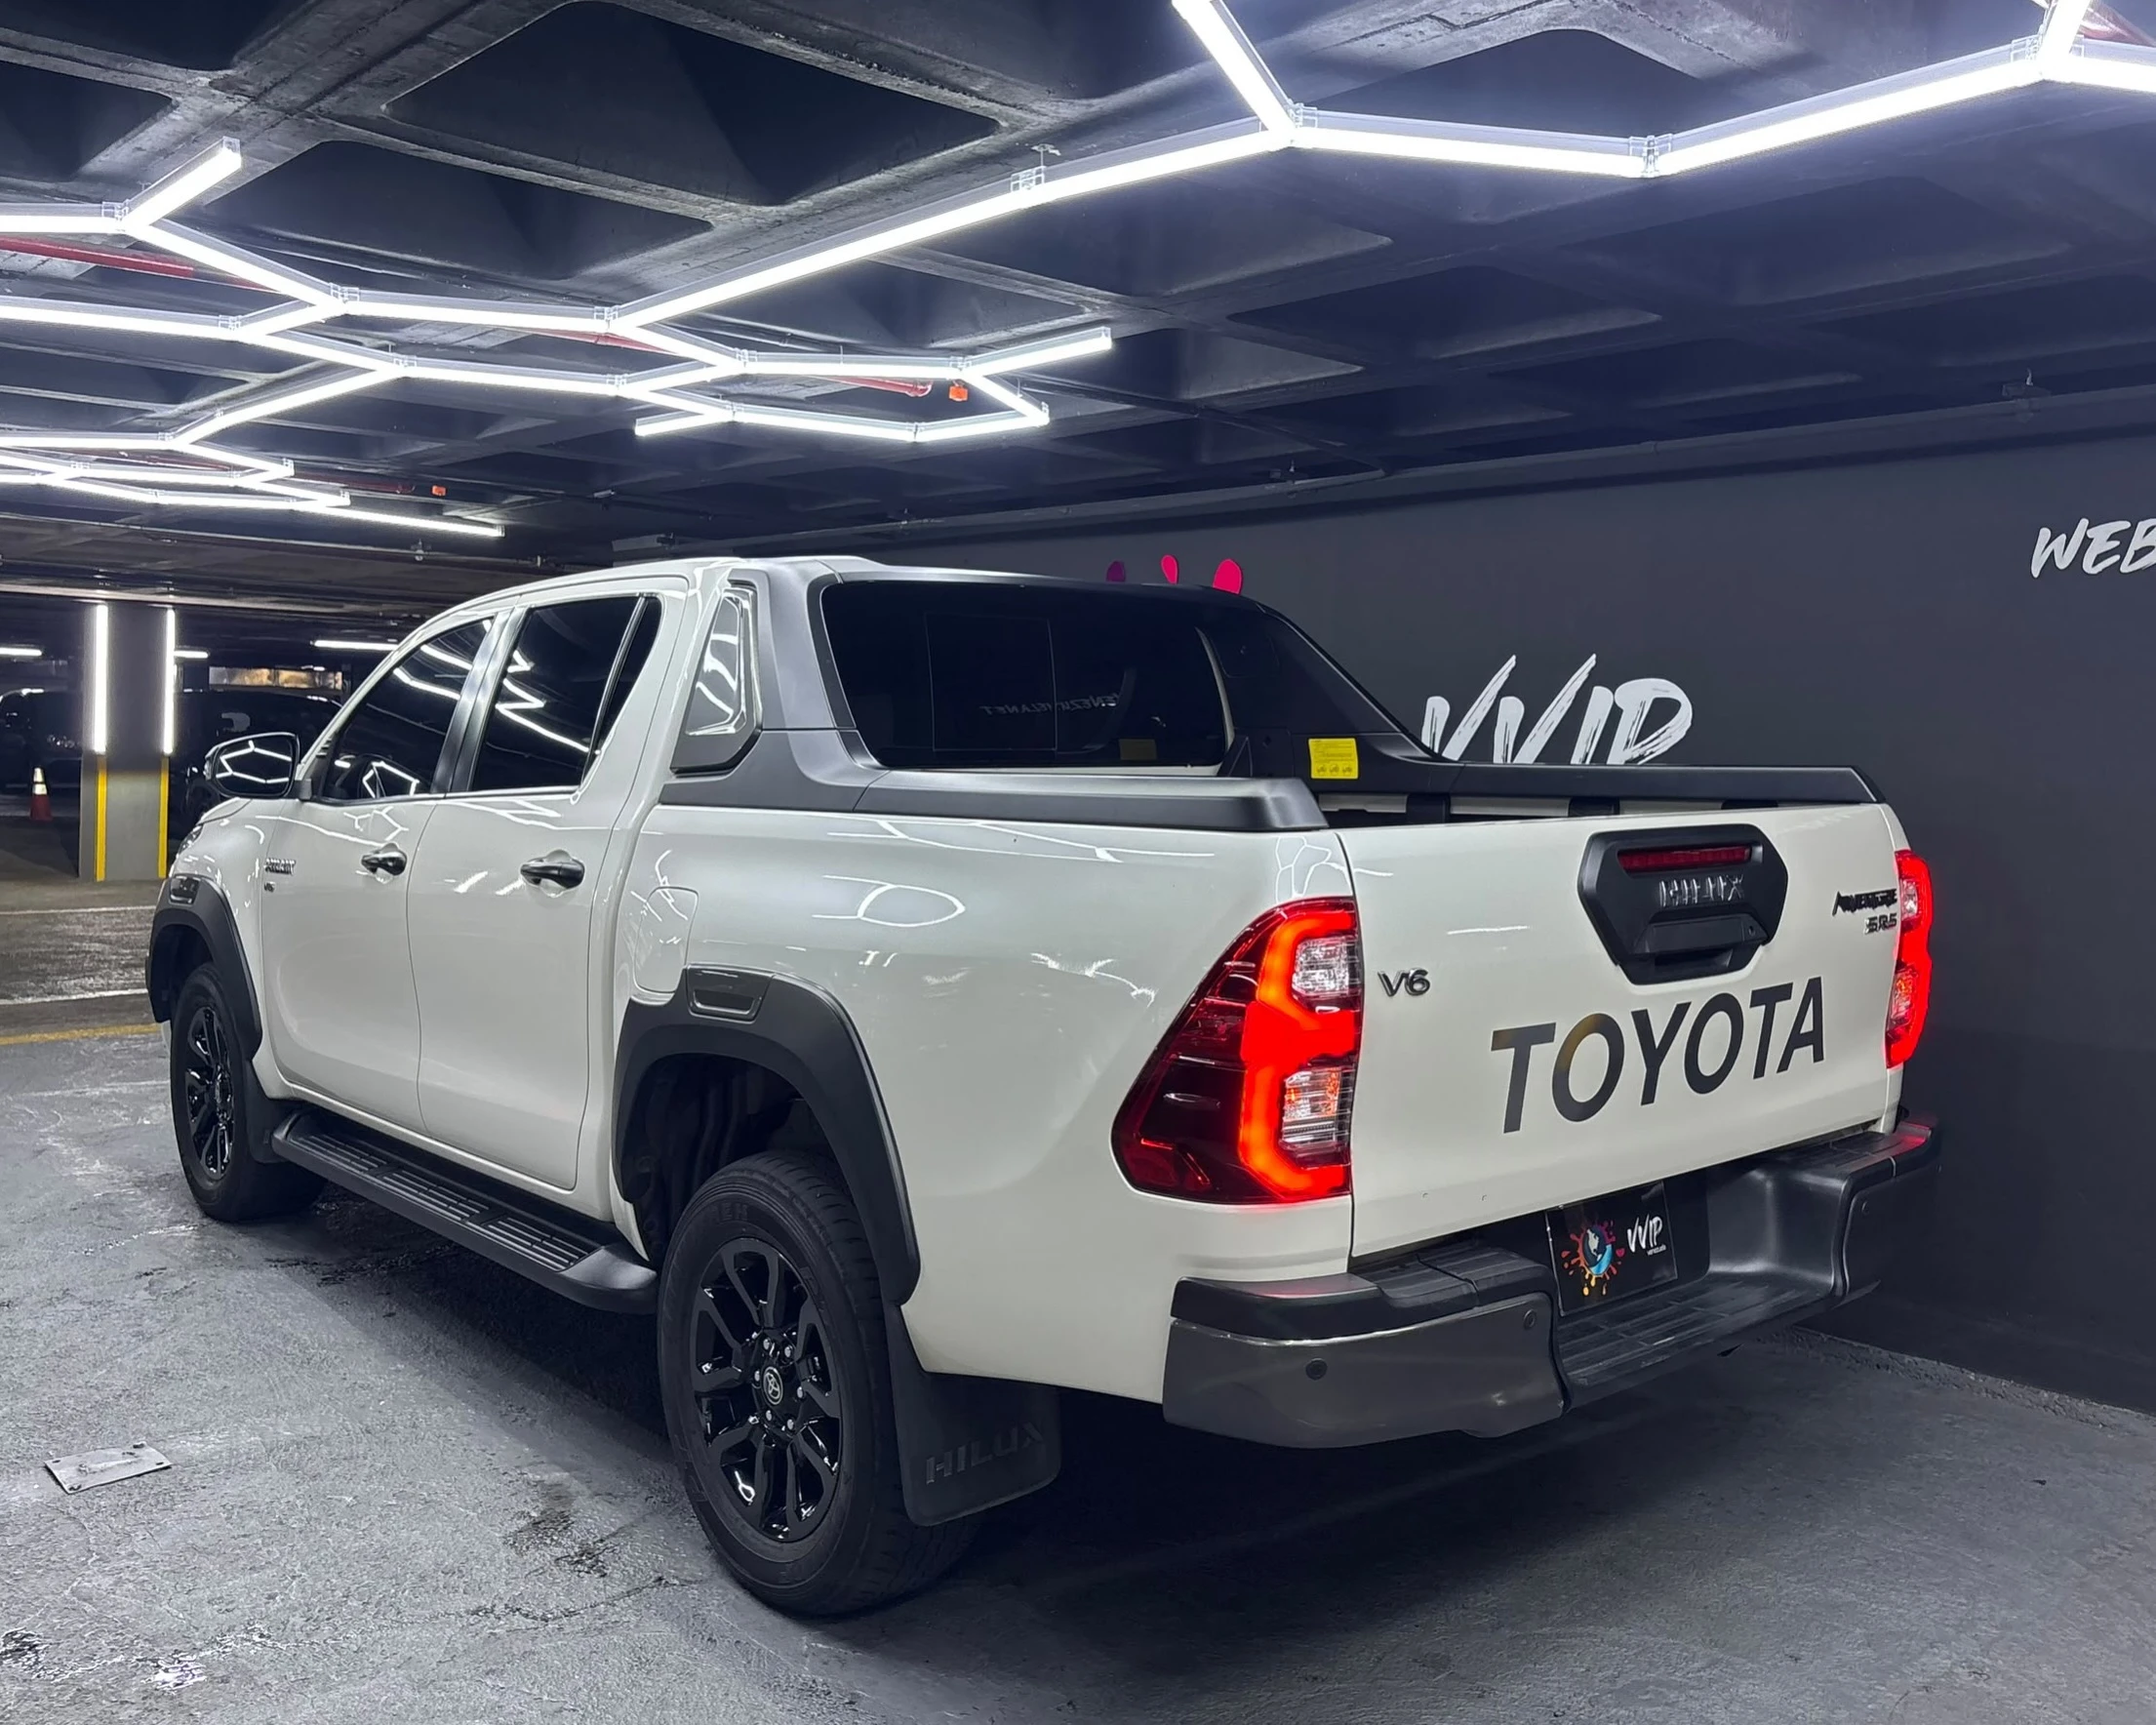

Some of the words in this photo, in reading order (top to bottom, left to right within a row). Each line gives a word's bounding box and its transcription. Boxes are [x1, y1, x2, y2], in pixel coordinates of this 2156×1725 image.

[2031, 518, 2156, 578] WEB
[1377, 968, 1431, 997] V6
[1491, 977, 1825, 1134] TOYOTA
[926, 1422, 1045, 1484] HILUX
